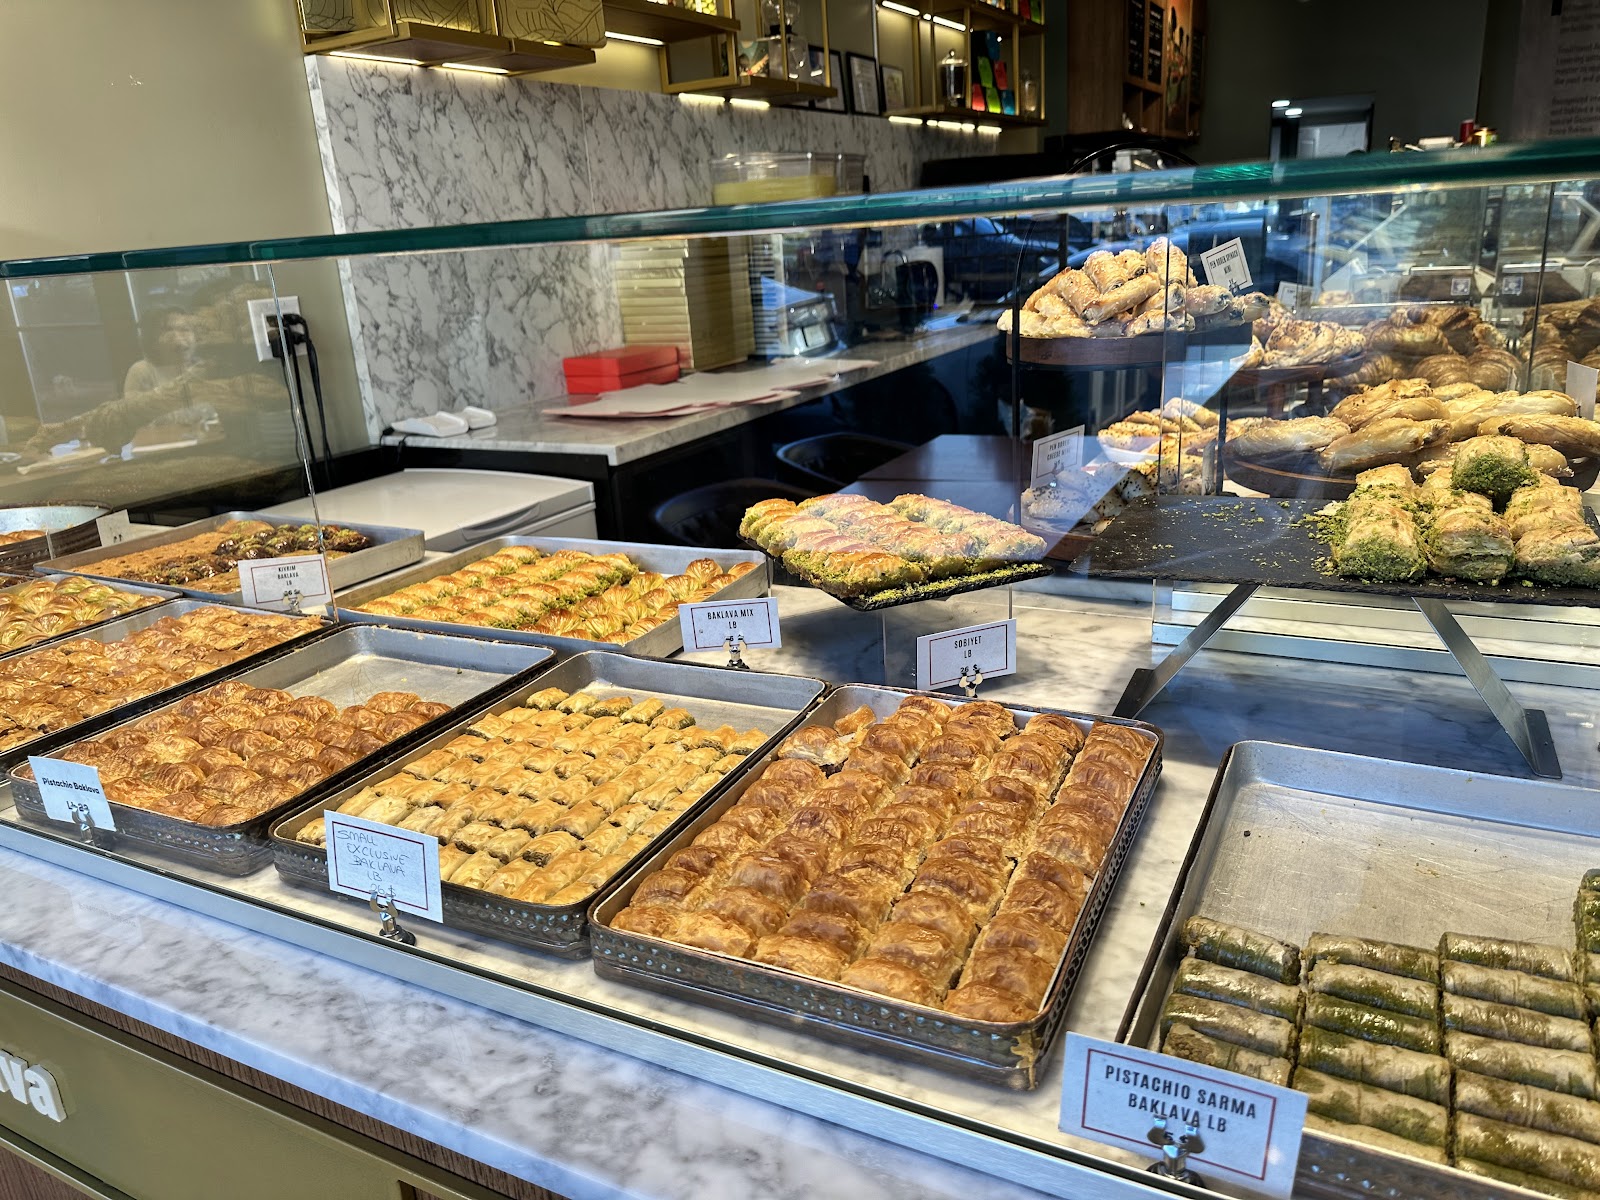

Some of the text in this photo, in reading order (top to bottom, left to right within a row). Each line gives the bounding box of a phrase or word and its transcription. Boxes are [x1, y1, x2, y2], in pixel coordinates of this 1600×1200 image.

[277, 572, 299, 580] BAKLAVA
[278, 564, 296, 573] KIVRIM
[707, 608, 754, 620] BAKLAVA MIX
[728, 620, 737, 629] LB
[954, 635, 982, 649] SOBIYET
[963, 649, 972, 659] LB
[41, 777, 100, 795] Pistachio Baklava
[336, 829, 378, 847] SMALL
[346, 842, 410, 865] EXCLUSIVE
[349, 855, 406, 878] BAKLAVA
[1105, 1064, 1257, 1119] PISTACHIO SARMA
[1127, 1092, 1227, 1133] BAKLAVA LB
